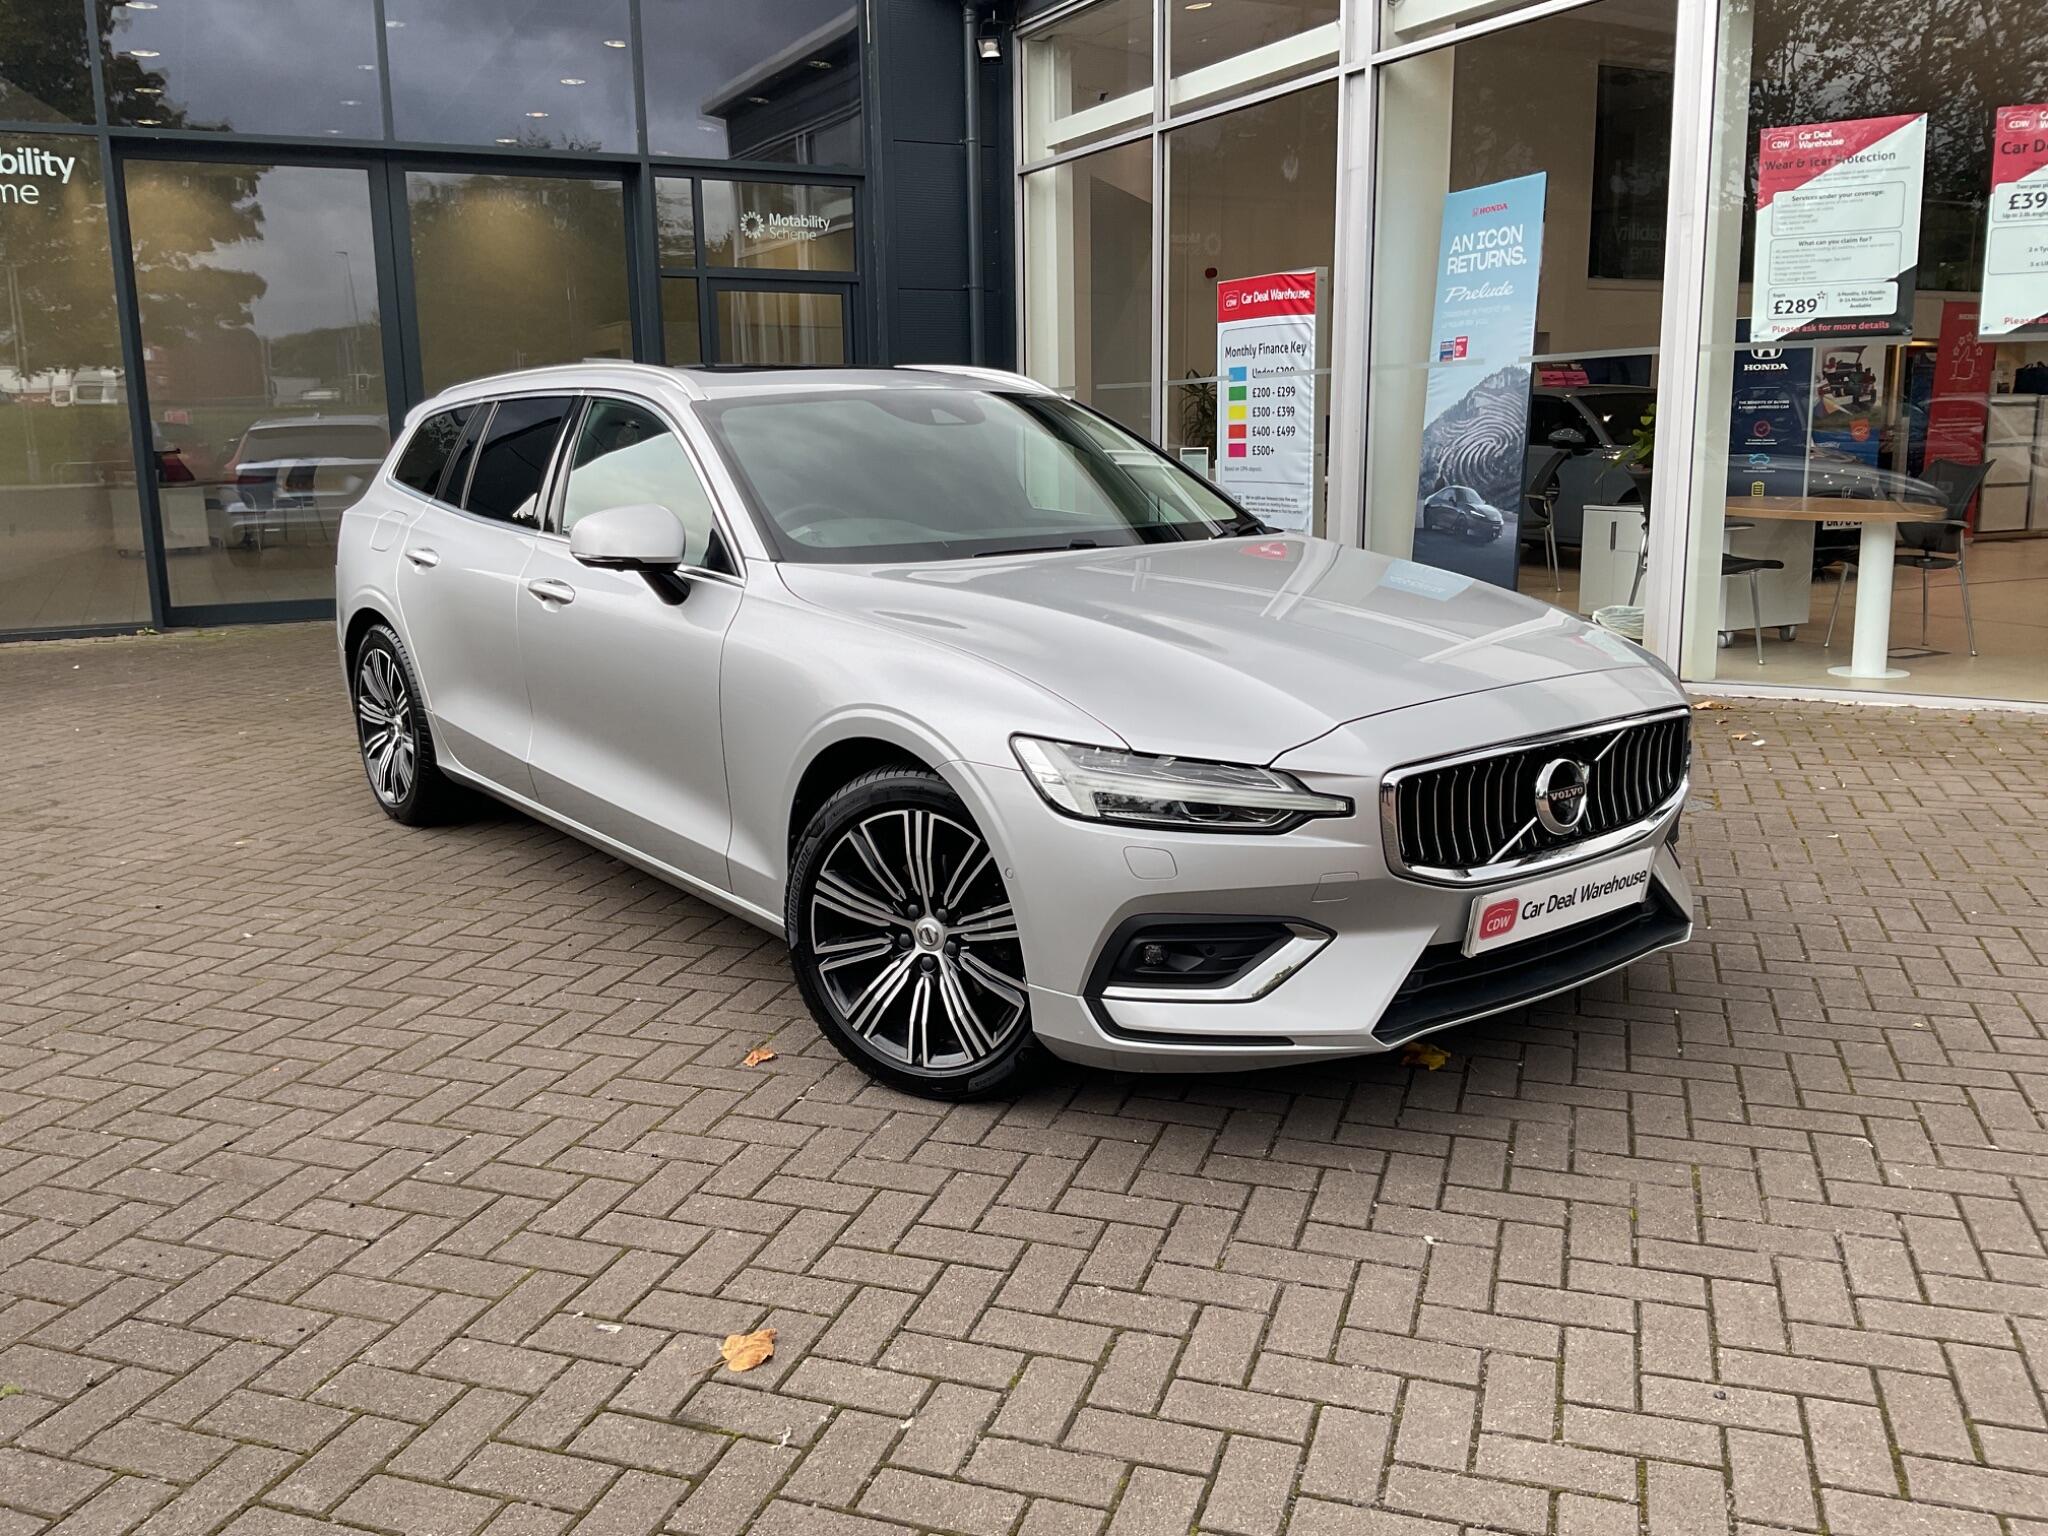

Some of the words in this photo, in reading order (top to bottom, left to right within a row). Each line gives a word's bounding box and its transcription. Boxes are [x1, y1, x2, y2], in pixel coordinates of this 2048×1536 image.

[2009, 120, 2030, 129] CDW
[1798, 131, 1812, 141] Car
[1814, 129, 1832, 139] Deal
[1772, 141, 1791, 149] CDW
[1798, 138, 1845, 149] Warehouse
[2001, 141, 2029, 155] Car
[1764, 159, 1794, 171] Wear
[1796, 159, 1805, 169] &
[1835, 151, 1896, 165] Protection
[1792, 194, 1818, 202] Services
[2008, 191, 2048, 210] £39
[1479, 203, 1508, 215] HONDA
[769, 213, 831, 232] Motability
[769, 227, 817, 241] Scheme
[1449, 233, 1474, 255] AN
[1476, 224, 1524, 250] ICON
[1447, 246, 1527, 275] RETURNS.
[1241, 292, 1253, 305] Car
[1254, 290, 1269, 303] Deal
[1270, 288, 1310, 301] Warehouse
[1445, 280, 1514, 304] Prelude
[1773, 298, 1817, 315] £289
[1772, 325, 1800, 334] Please
[1802, 324, 1816, 333] ask
[1818, 323, 1831, 332] for
[1833, 323, 1856, 331] more
[1859, 321, 1890, 330] details
[1225, 343, 1257, 359] Monthly
[1258, 343, 1289, 355] Finance
[1290, 341, 1307, 356] Key
[1743, 363, 1789, 371] HONDA
[1252, 387, 1271, 398] £200
[1277, 386, 1296, 398] £299
[1252, 406, 1271, 417] £300
[1277, 406, 1295, 417] £399
[1252, 426, 1271, 437] £400
[1277, 426, 1296, 437] £499
[1252, 445, 1275, 456] £500+
[1550, 786, 1584, 801] VOLVO
[789, 846, 812, 931] BRIDGESTONE
[1486, 914, 1512, 932] CDW
[1521, 901, 1545, 920] Car
[1546, 888, 1577, 914] Deal
[1580, 869, 1647, 903] Warehouse
